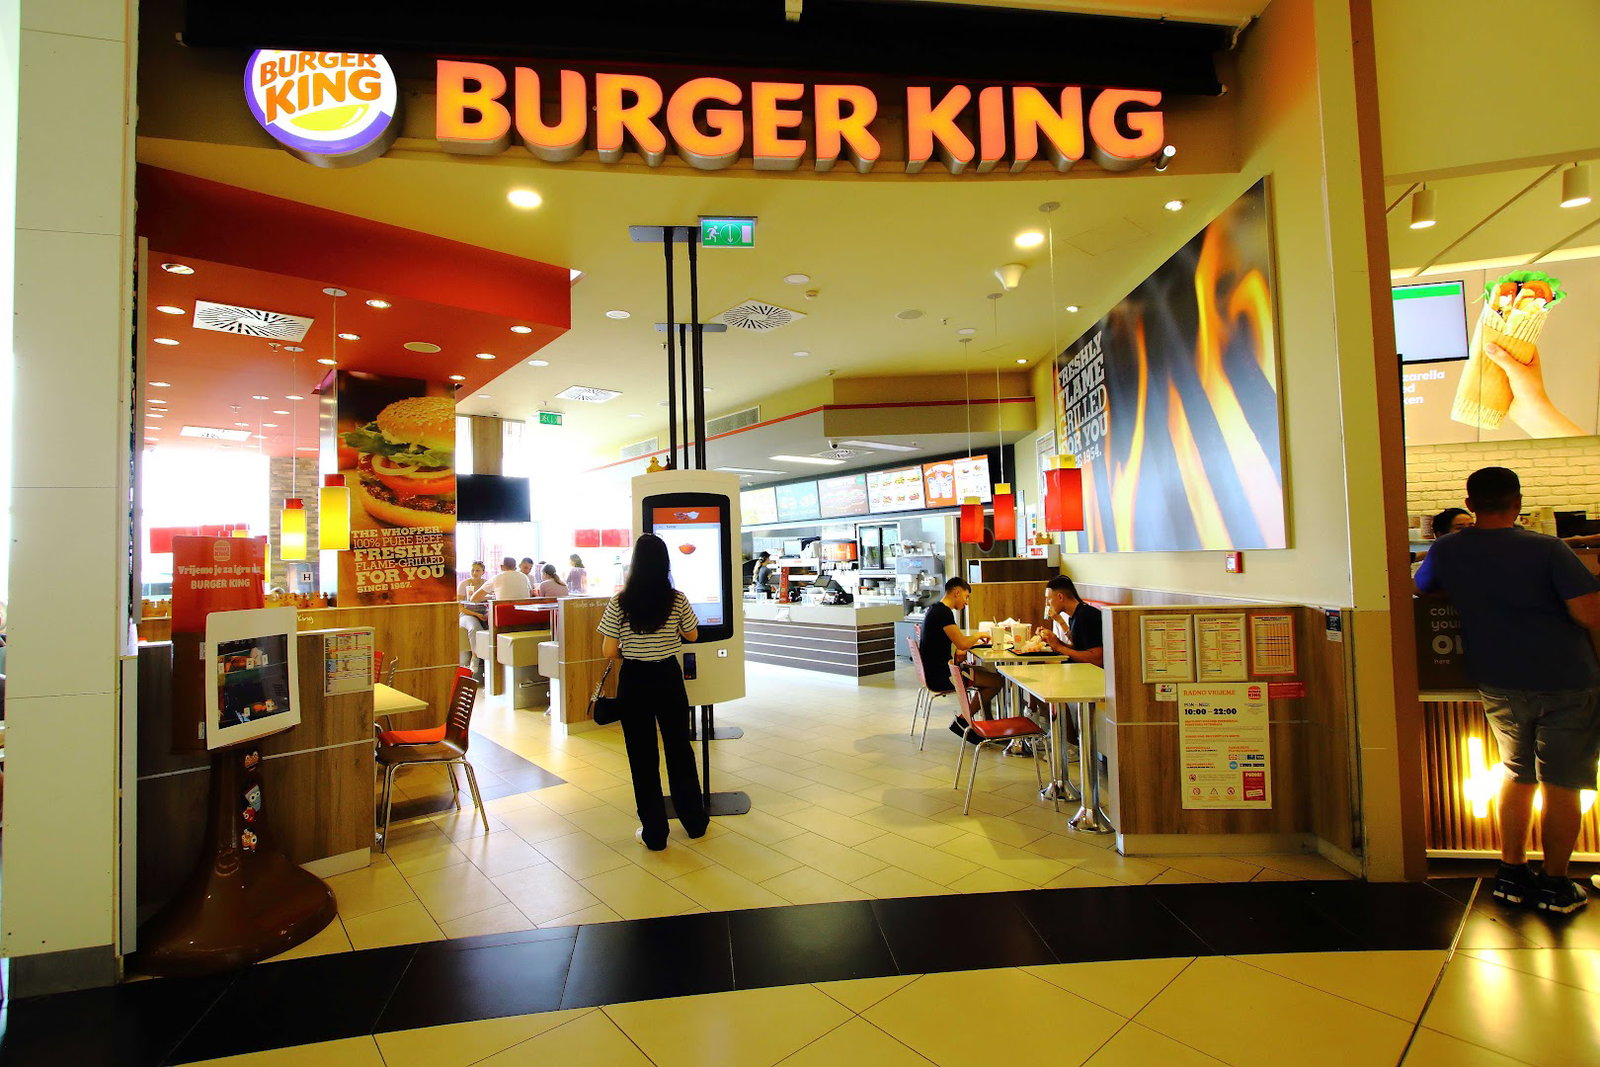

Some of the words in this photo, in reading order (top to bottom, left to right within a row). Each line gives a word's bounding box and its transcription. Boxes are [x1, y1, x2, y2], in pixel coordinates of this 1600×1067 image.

[260, 51, 377, 87] BURGER
[265, 68, 382, 124] KING
[436, 59, 882, 166] BURGER
[906, 83, 1165, 168] KING
[1057, 352, 1105, 415] FLAME
[1060, 383, 1107, 440] GRILLED
[1082, 410, 1108, 443] YOU
[350, 529, 378, 538] THE
[353, 537, 380, 549] 100%
[382, 535, 414, 547] PURE
[354, 543, 444, 562] FRESHLY
[355, 555, 445, 571] FLAME-GRILLED
[191, 579, 227, 590] BURGER
[229, 578, 250, 588] KING
[356, 568, 400, 586] FOR
[403, 564, 445, 581] YOU
[357, 583, 389, 594] SINCE
[1213, 707, 1237, 715] 22:00
